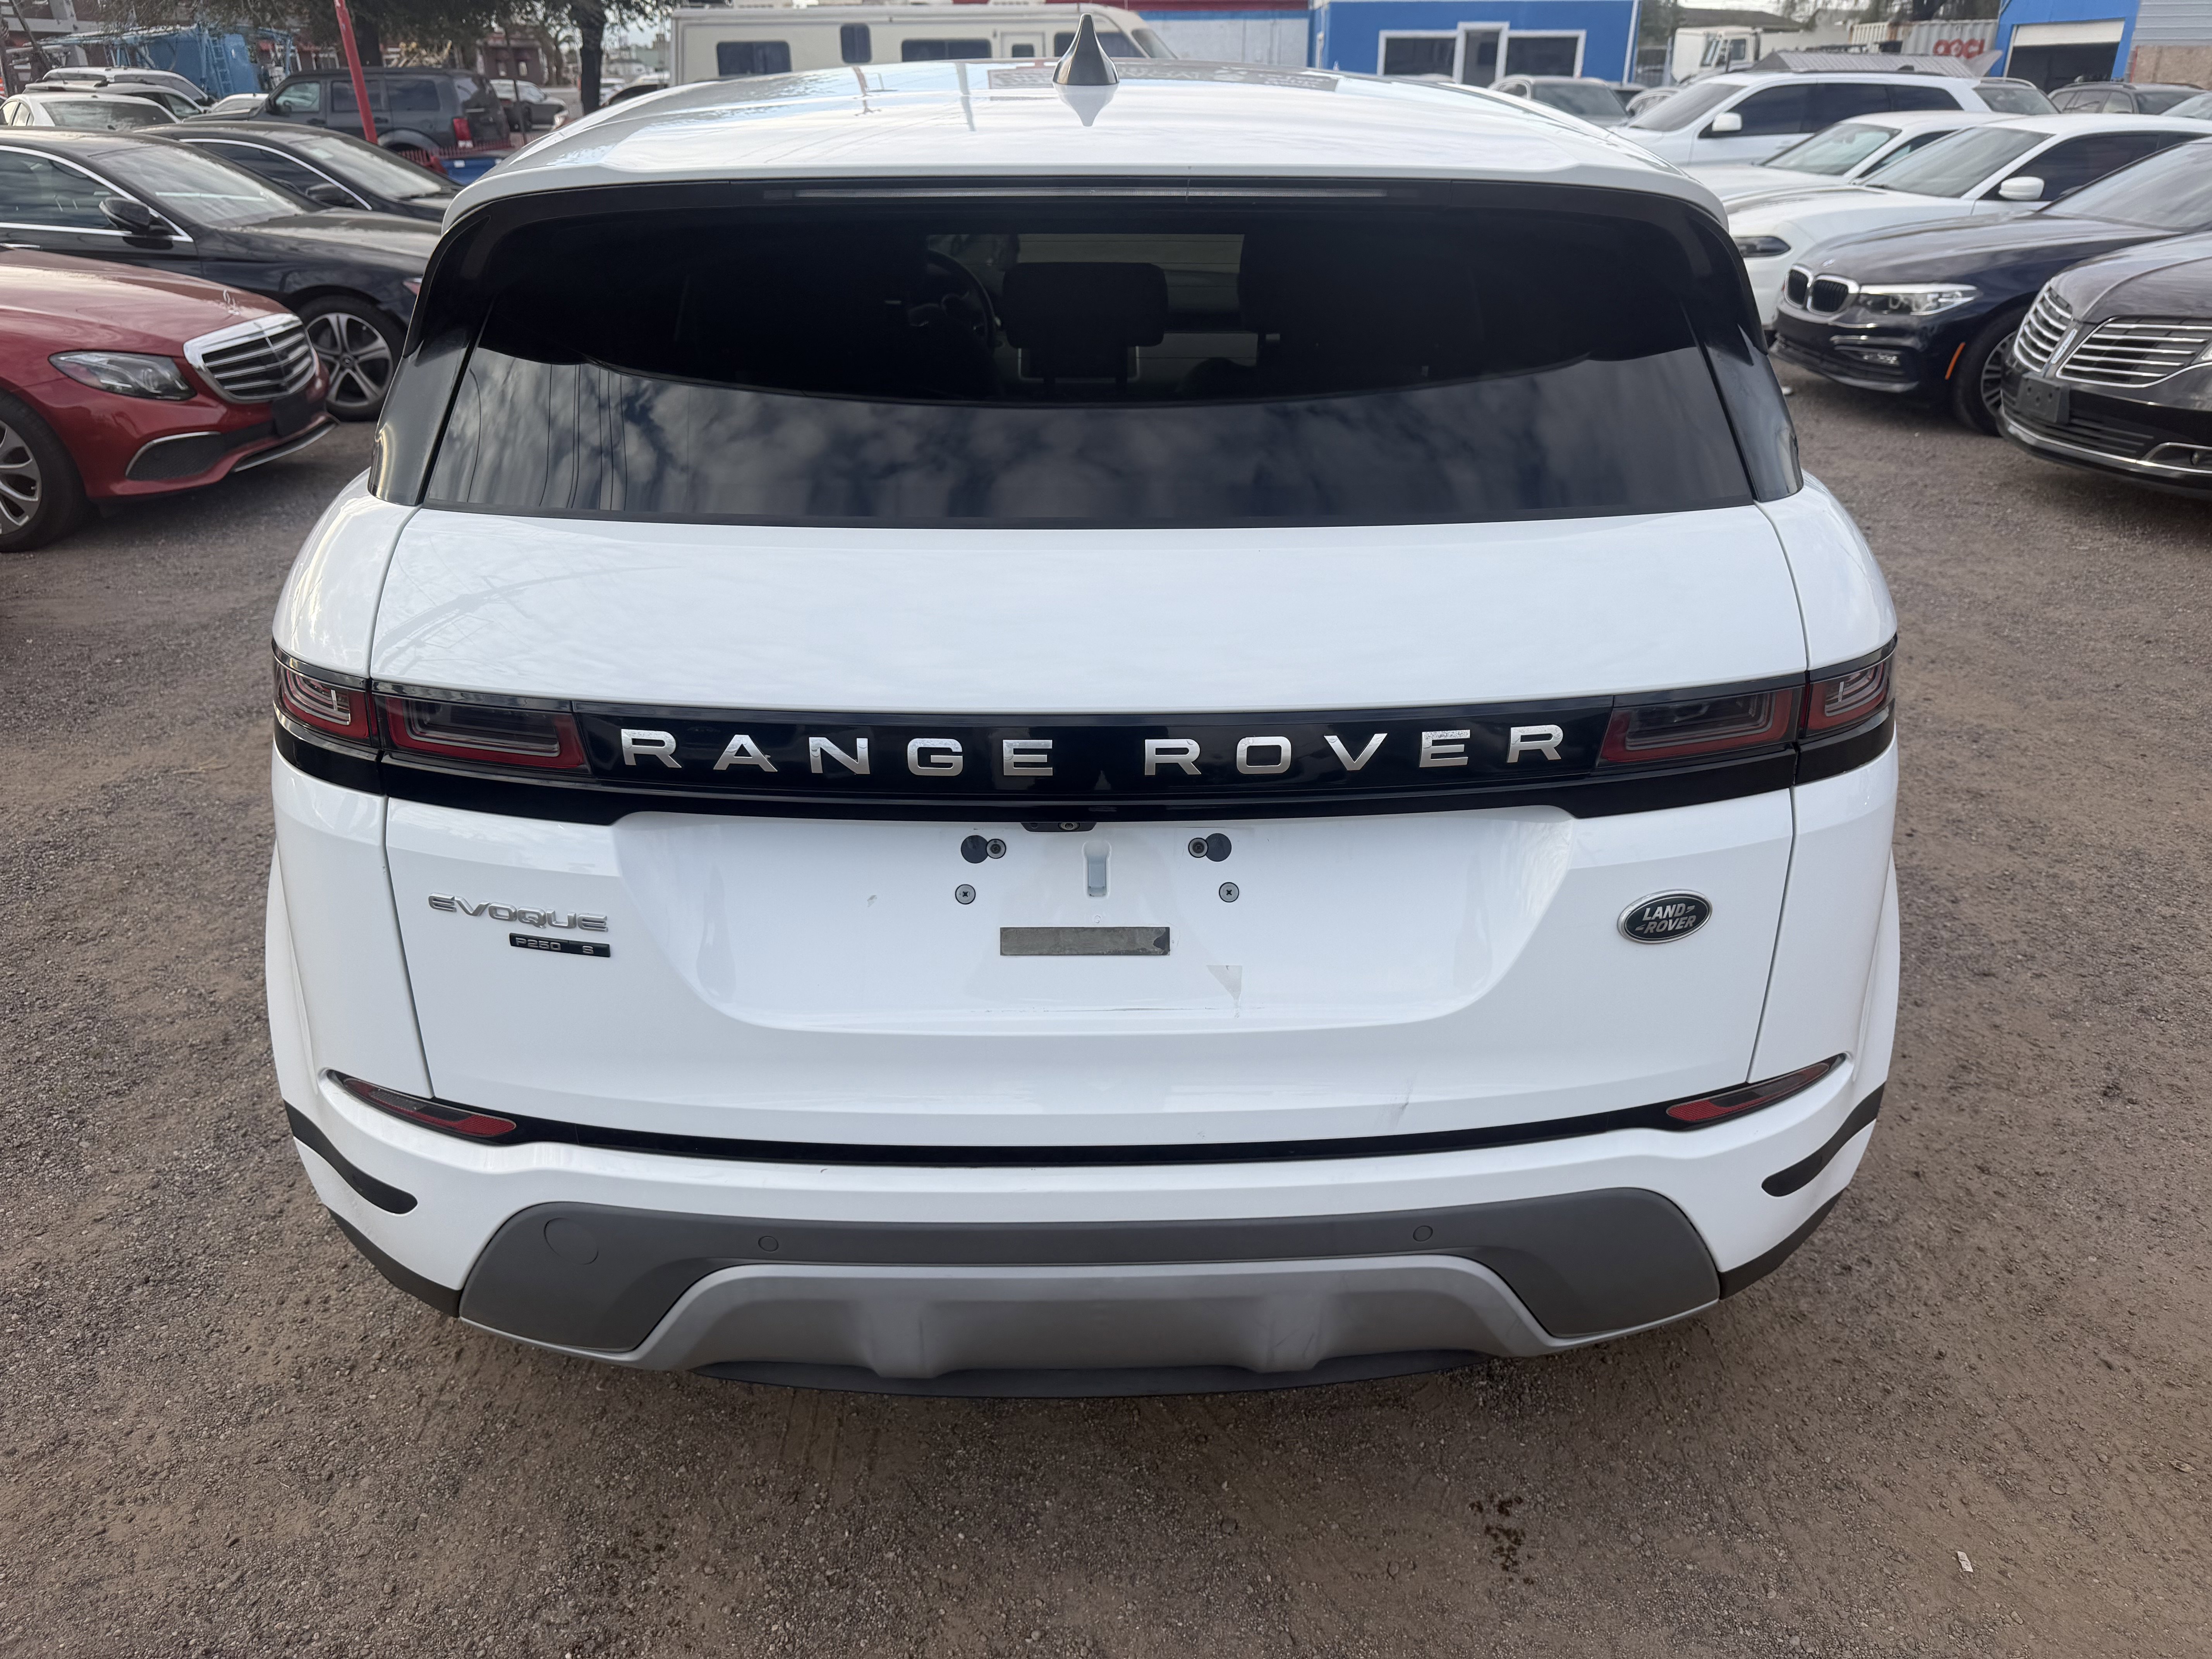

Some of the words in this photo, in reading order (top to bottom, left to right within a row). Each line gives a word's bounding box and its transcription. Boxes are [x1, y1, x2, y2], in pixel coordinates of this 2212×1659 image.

[621, 728, 1053, 776] RANGE
[1144, 725, 1564, 776] ROVER
[428, 892, 609, 933] EVOQUE
[1642, 903, 1686, 921] LAND
[1643, 915, 1697, 934] ROVER
[515, 937, 562, 951] P250
[582, 945, 594, 955] S
